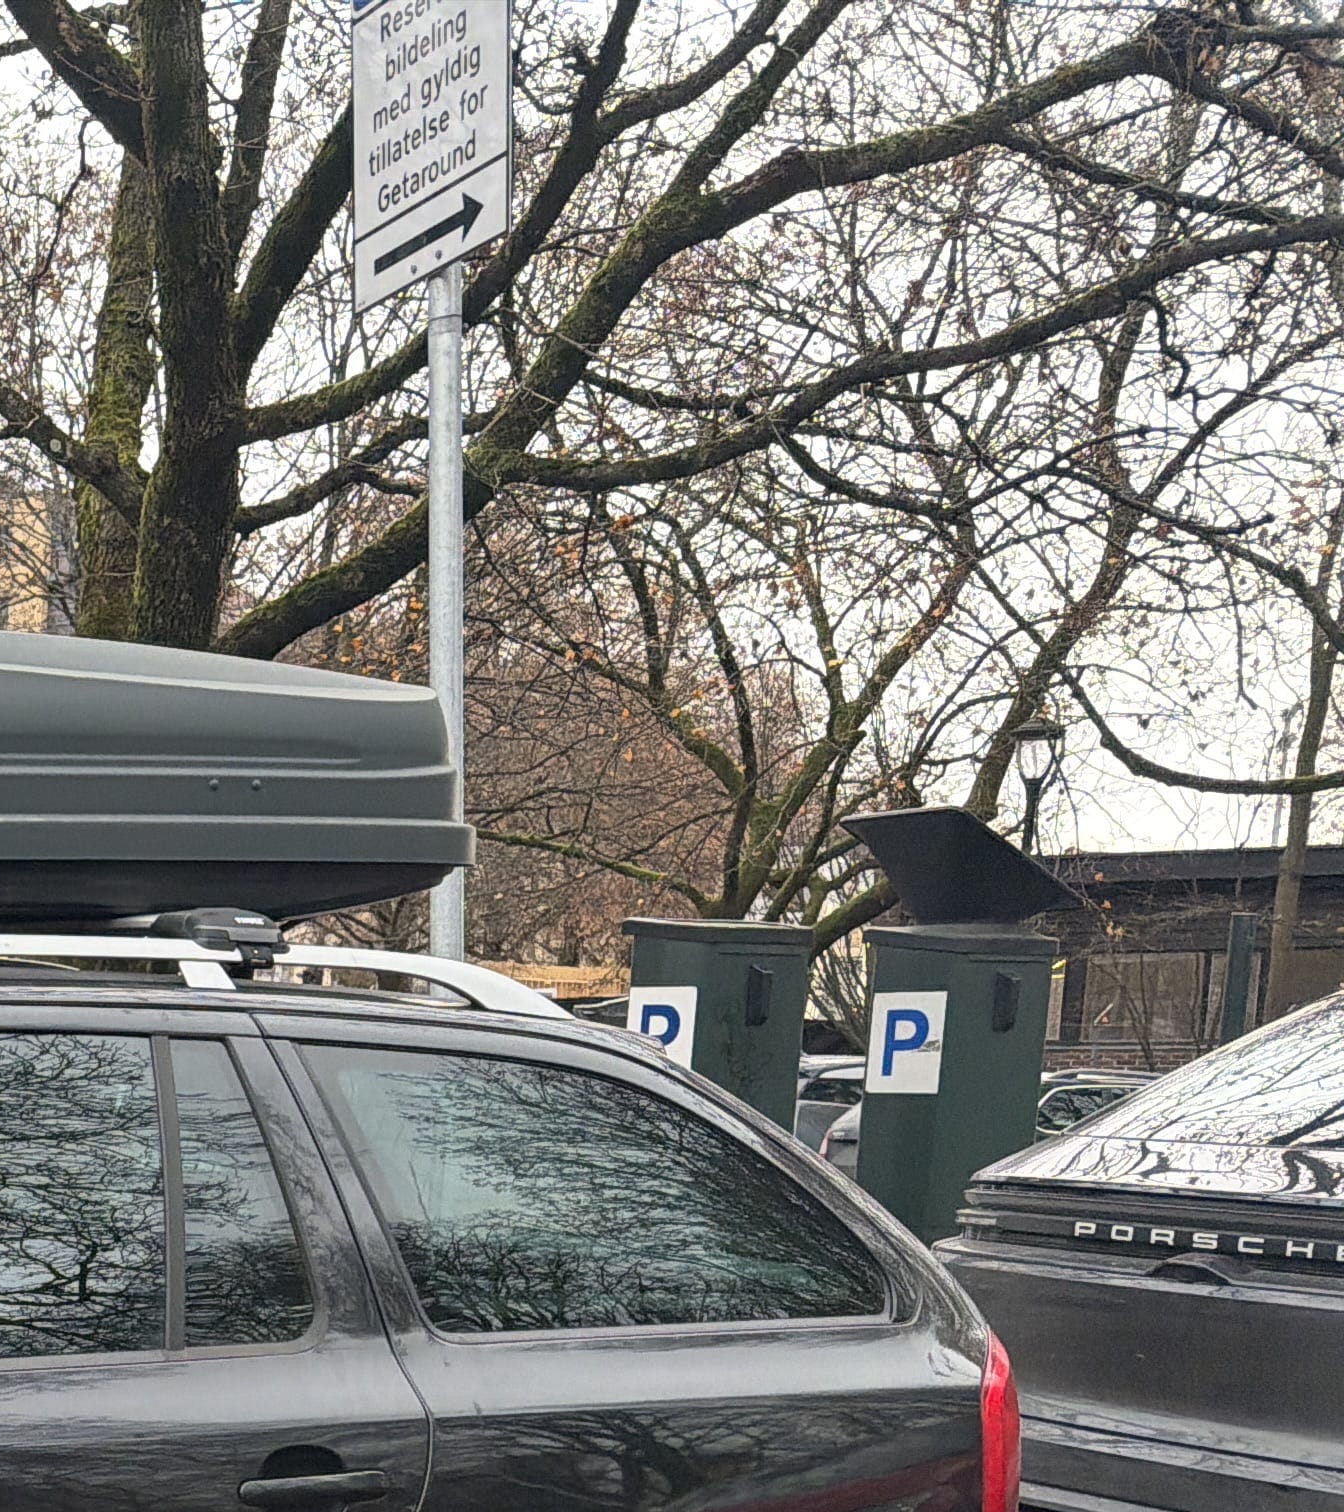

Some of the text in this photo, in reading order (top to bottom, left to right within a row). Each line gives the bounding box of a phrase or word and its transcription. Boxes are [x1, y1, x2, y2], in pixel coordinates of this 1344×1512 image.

[385, 9, 466, 82] bildeling
[368, 84, 488, 177] tillatelse for
[373, 44, 480, 133] med gyldig
[377, 128, 476, 213] Getaround
[881, 1009, 929, 1076] P
